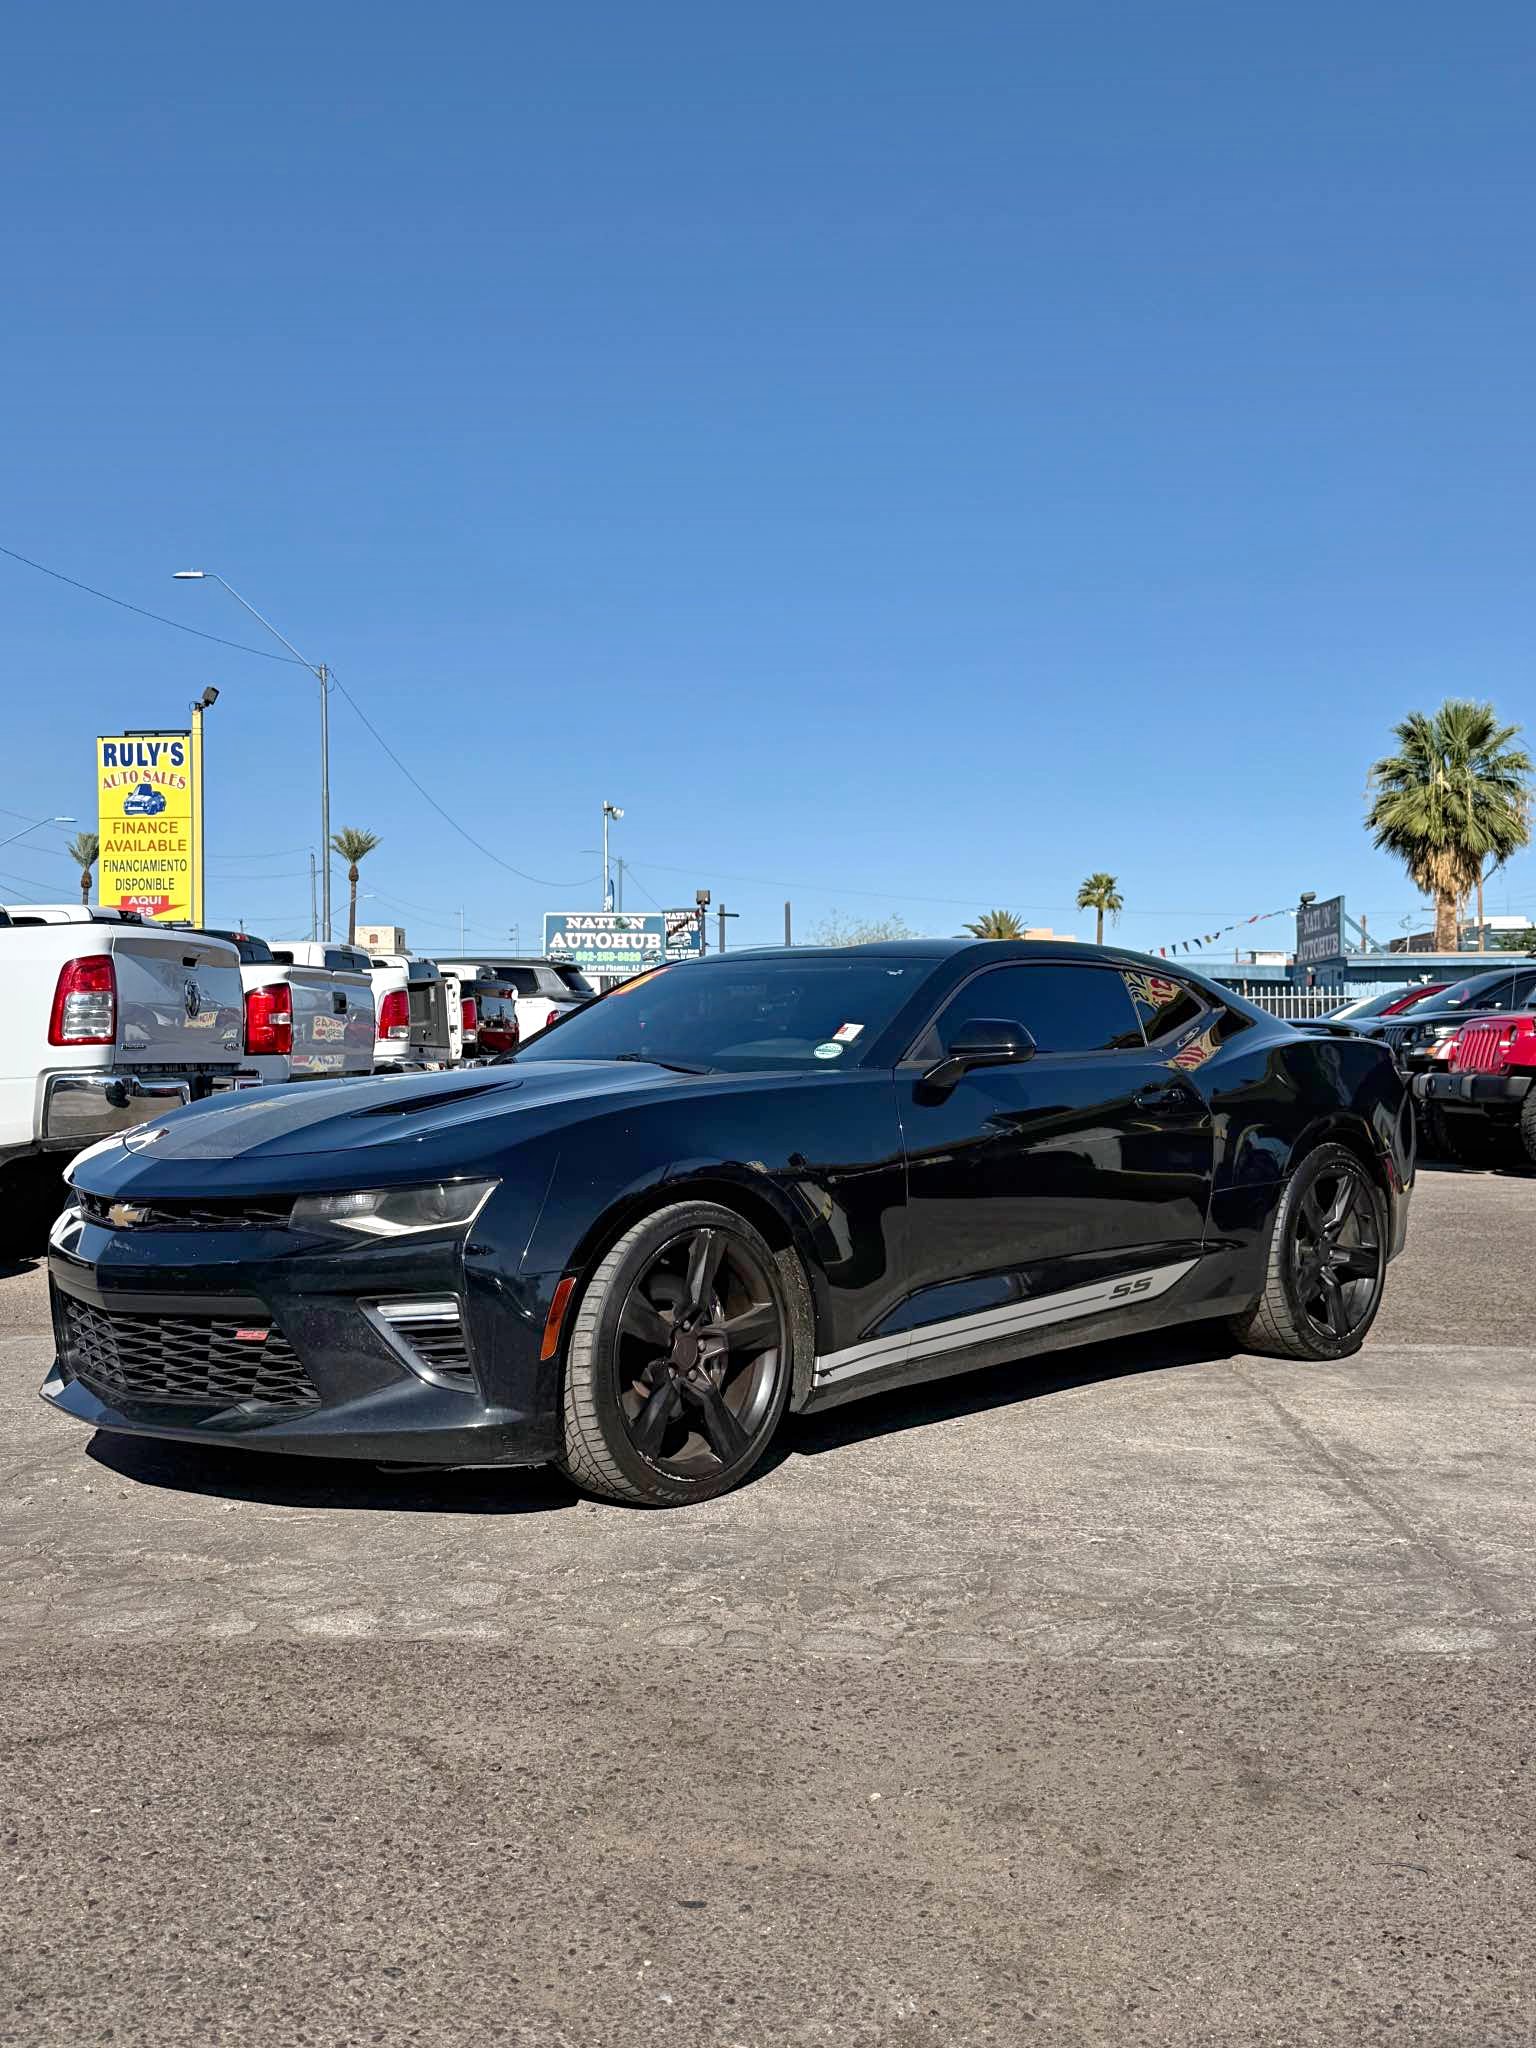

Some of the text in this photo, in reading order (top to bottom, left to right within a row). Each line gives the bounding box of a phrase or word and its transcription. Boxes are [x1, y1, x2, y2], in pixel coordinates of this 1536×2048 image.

[103, 742, 184, 767] RULY'S
[103, 770, 186, 789] AUTO SALES
[113, 821, 178, 834] FINANCE
[104, 839, 187, 852] AVAILABLE
[103, 859, 187, 872] FINANCIAMIENTO
[115, 878, 174, 891] DISPONIBLE
[128, 896, 161, 905] AQUI
[137, 907, 154, 916] ES
[550, 932, 661, 949] AUTOHUB
[1109, 1276, 1153, 1300] SS
